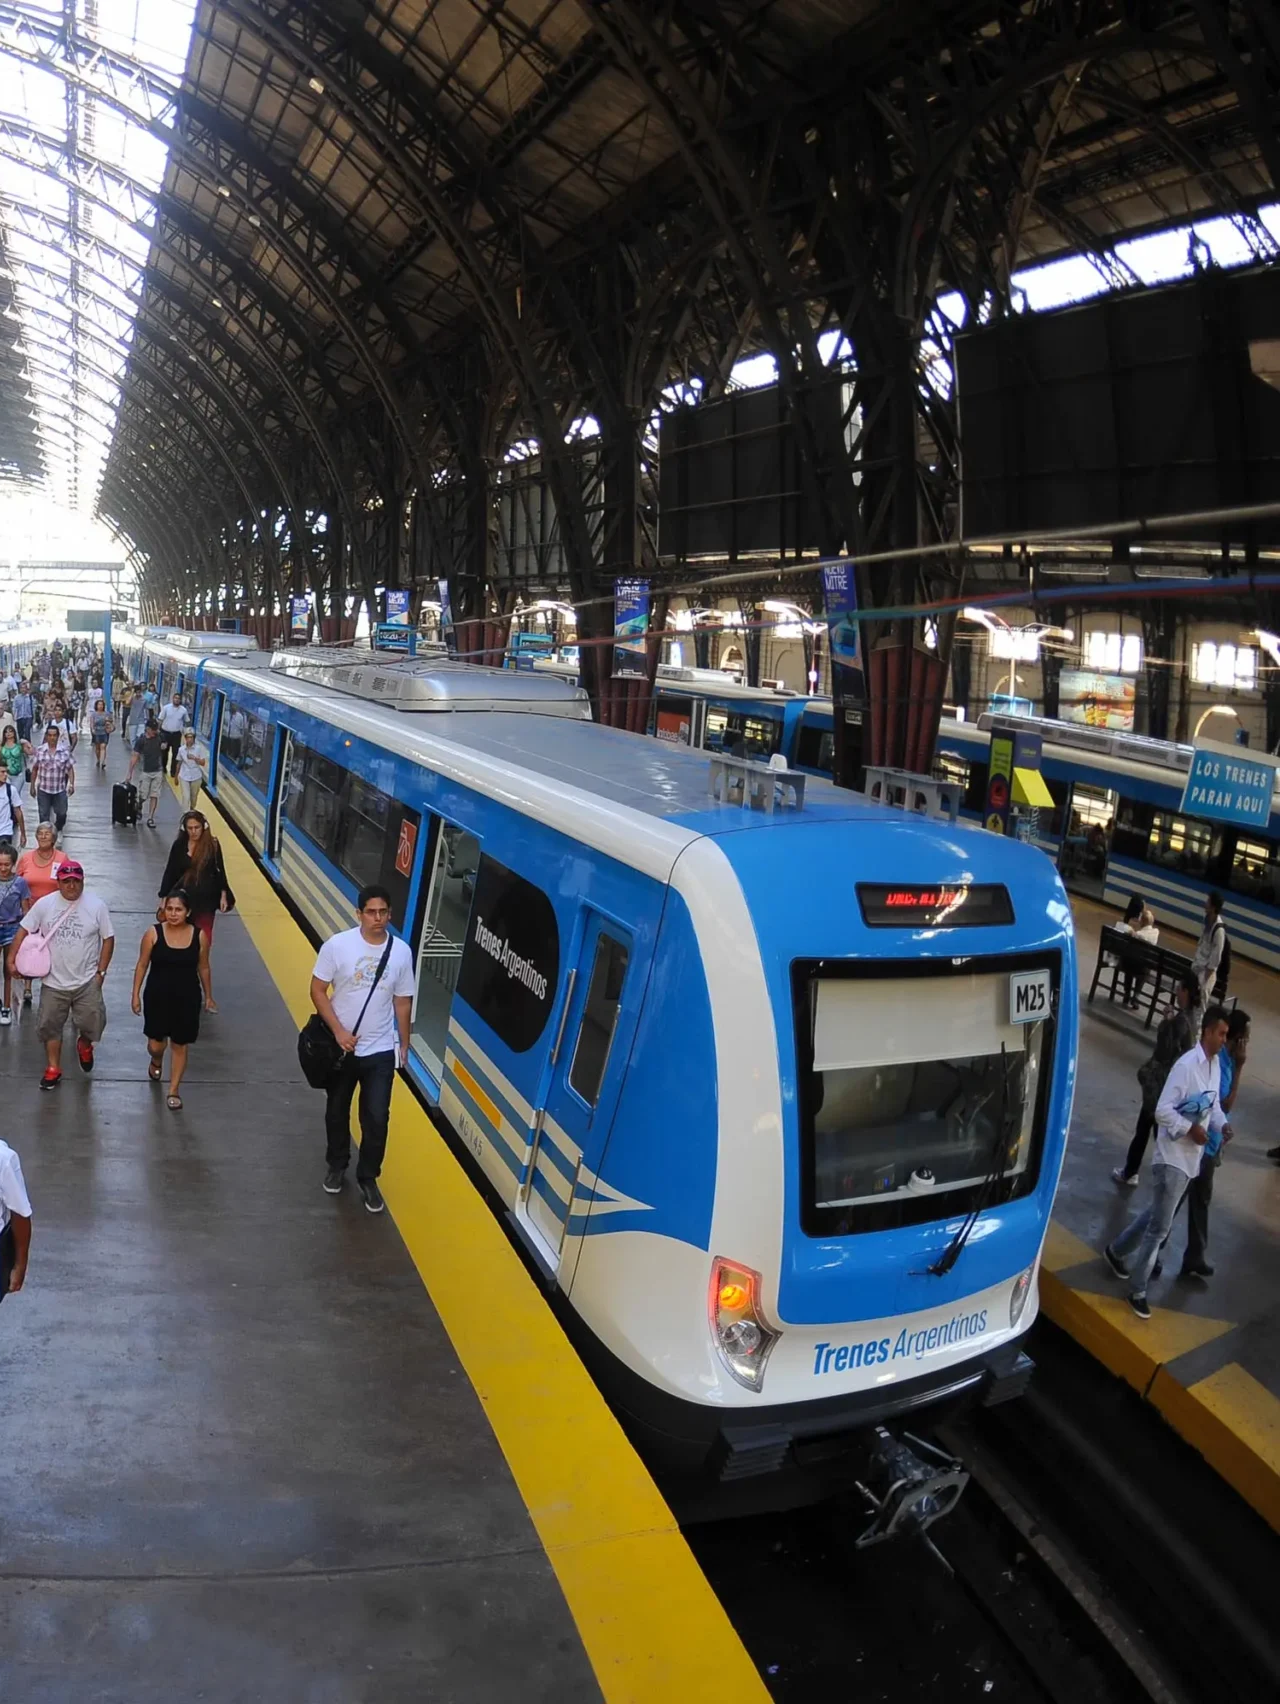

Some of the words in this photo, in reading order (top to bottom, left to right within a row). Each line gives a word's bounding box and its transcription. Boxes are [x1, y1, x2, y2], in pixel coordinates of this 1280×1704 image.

[825, 575, 848, 590] MITRE
[1196, 760, 1220, 779] LOS
[1225, 765, 1267, 788] TRENES
[1191, 786, 1232, 808] PARAN
[1235, 795, 1264, 815] AQUI
[475, 915, 502, 960] Trenes
[499, 938, 547, 1000] Argentinos
[1016, 983, 1045, 1014] M25
[813, 1338, 891, 1375] Trenes
[892, 1309, 988, 1361] Argentinos
